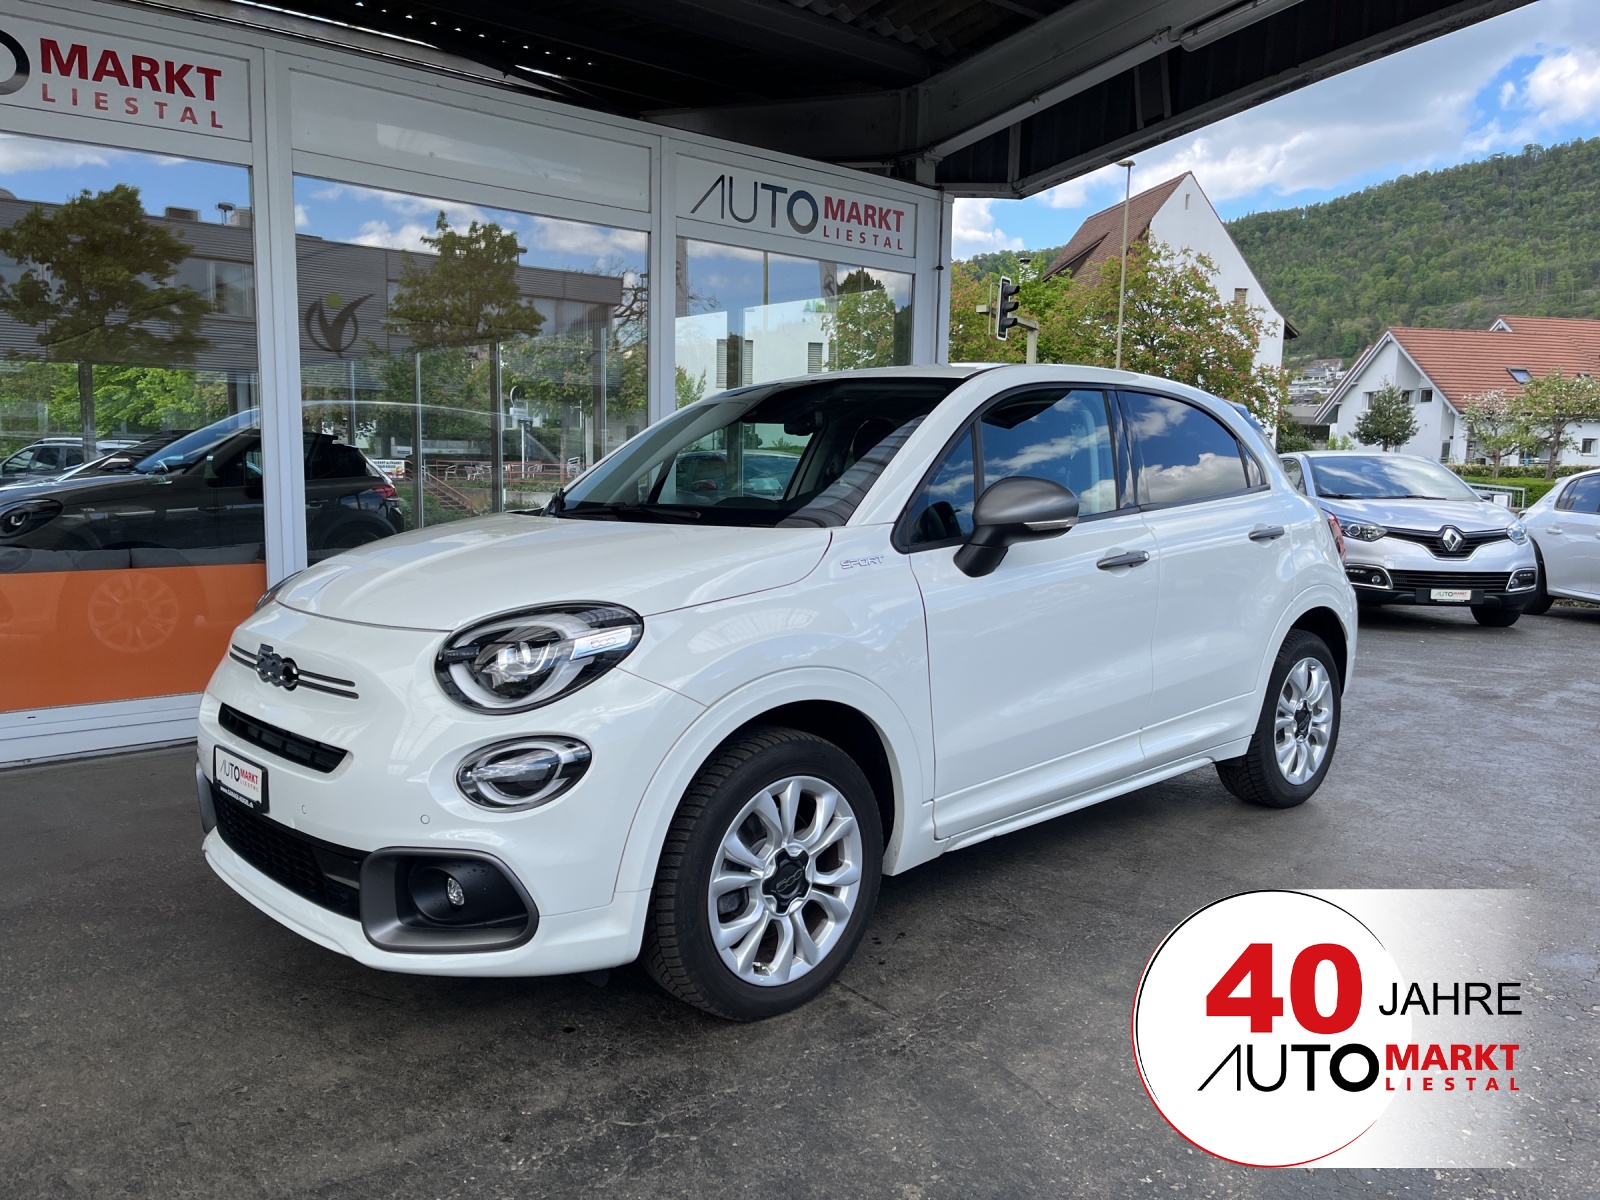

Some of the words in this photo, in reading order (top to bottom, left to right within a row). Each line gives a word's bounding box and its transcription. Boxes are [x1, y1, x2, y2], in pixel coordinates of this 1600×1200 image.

[40, 38, 222, 101] MARKT
[41, 83, 223, 129] LIESTAL
[823, 225, 903, 250] LIESTAL
[840, 555, 884, 569] SPORT
